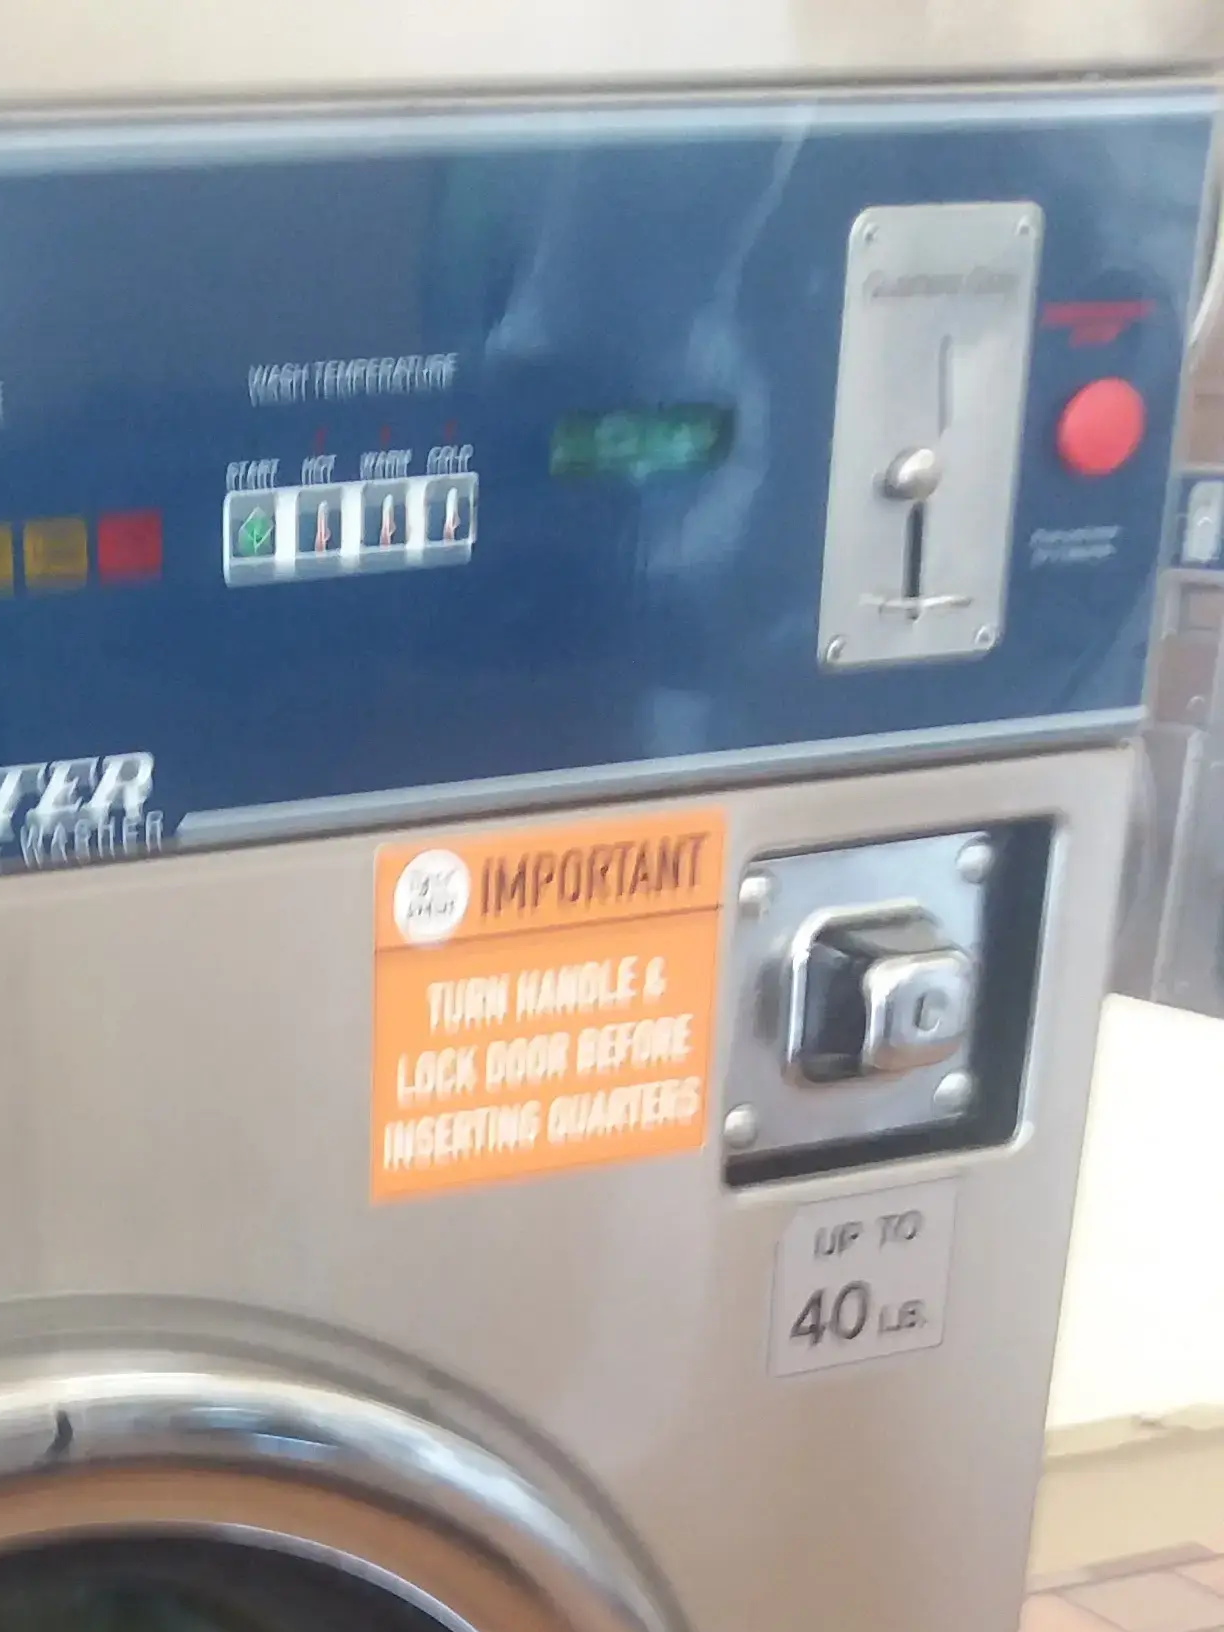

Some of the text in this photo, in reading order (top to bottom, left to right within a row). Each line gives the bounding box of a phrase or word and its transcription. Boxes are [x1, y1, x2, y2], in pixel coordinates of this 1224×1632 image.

[248, 353, 459, 407] WASH TEMPERATURE
[480, 831, 709, 919] IMPORTANT
[427, 955, 668, 1032] TURN HANDLE &
[396, 1013, 694, 1107] LOCK DOOR BEFORE
[383, 1075, 701, 1171] INSERTING QUARTERS
[813, 1209, 923, 1259] UP TO
[789, 1279, 871, 1348] 40
